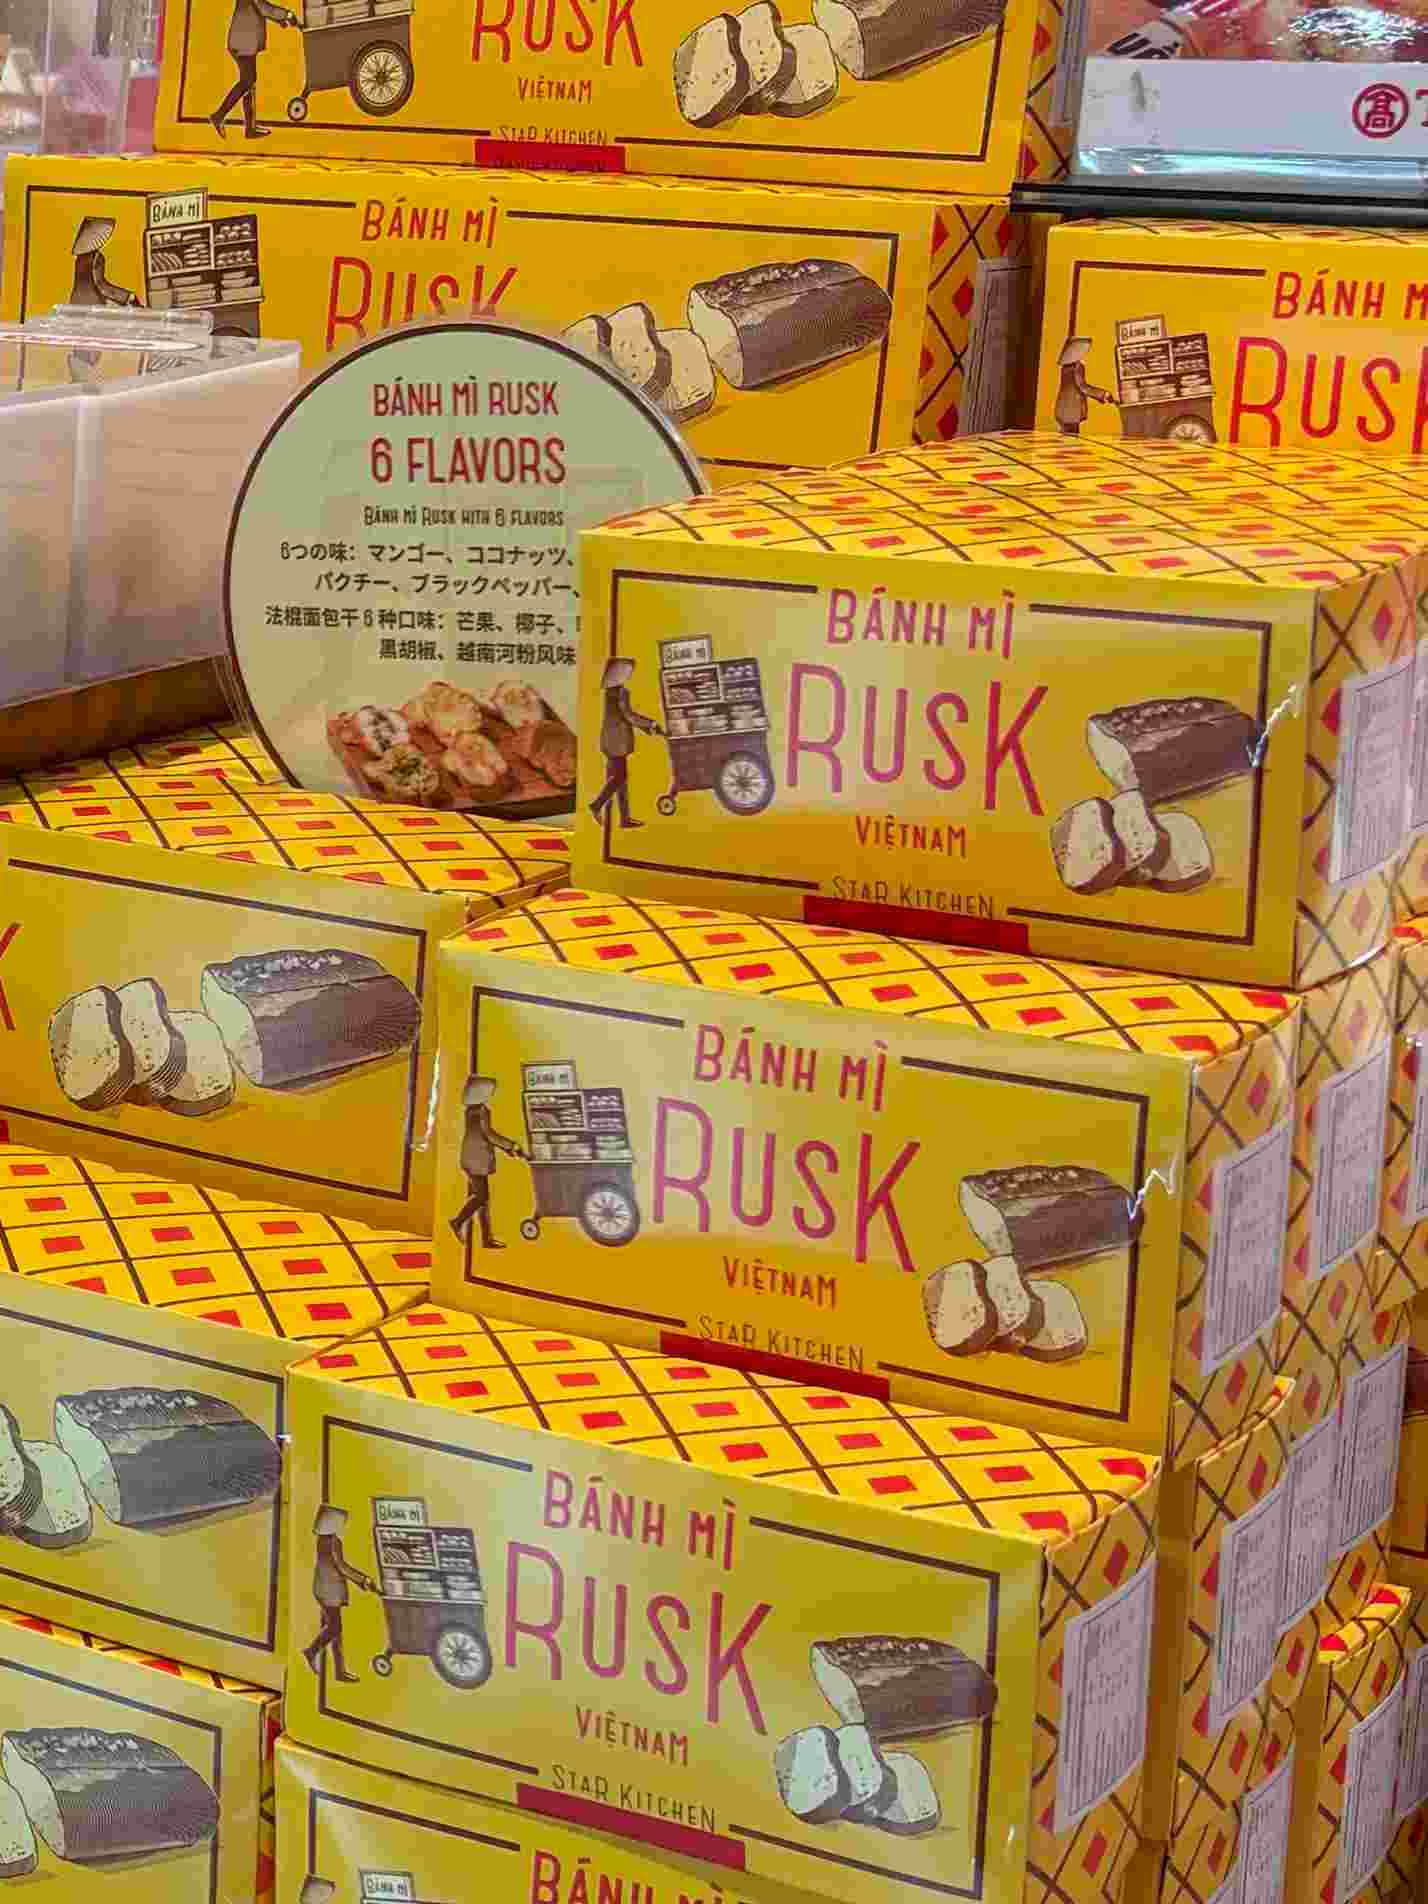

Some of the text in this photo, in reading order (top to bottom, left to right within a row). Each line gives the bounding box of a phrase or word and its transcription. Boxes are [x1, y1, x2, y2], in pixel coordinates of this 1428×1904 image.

[372, 375, 560, 418] BÁNH MÌ RUSK
[370, 437, 566, 484] 6 FLAVORS
[827, 586, 1015, 658] BÁNH MÌ
[786, 663, 1048, 816] RUSK
